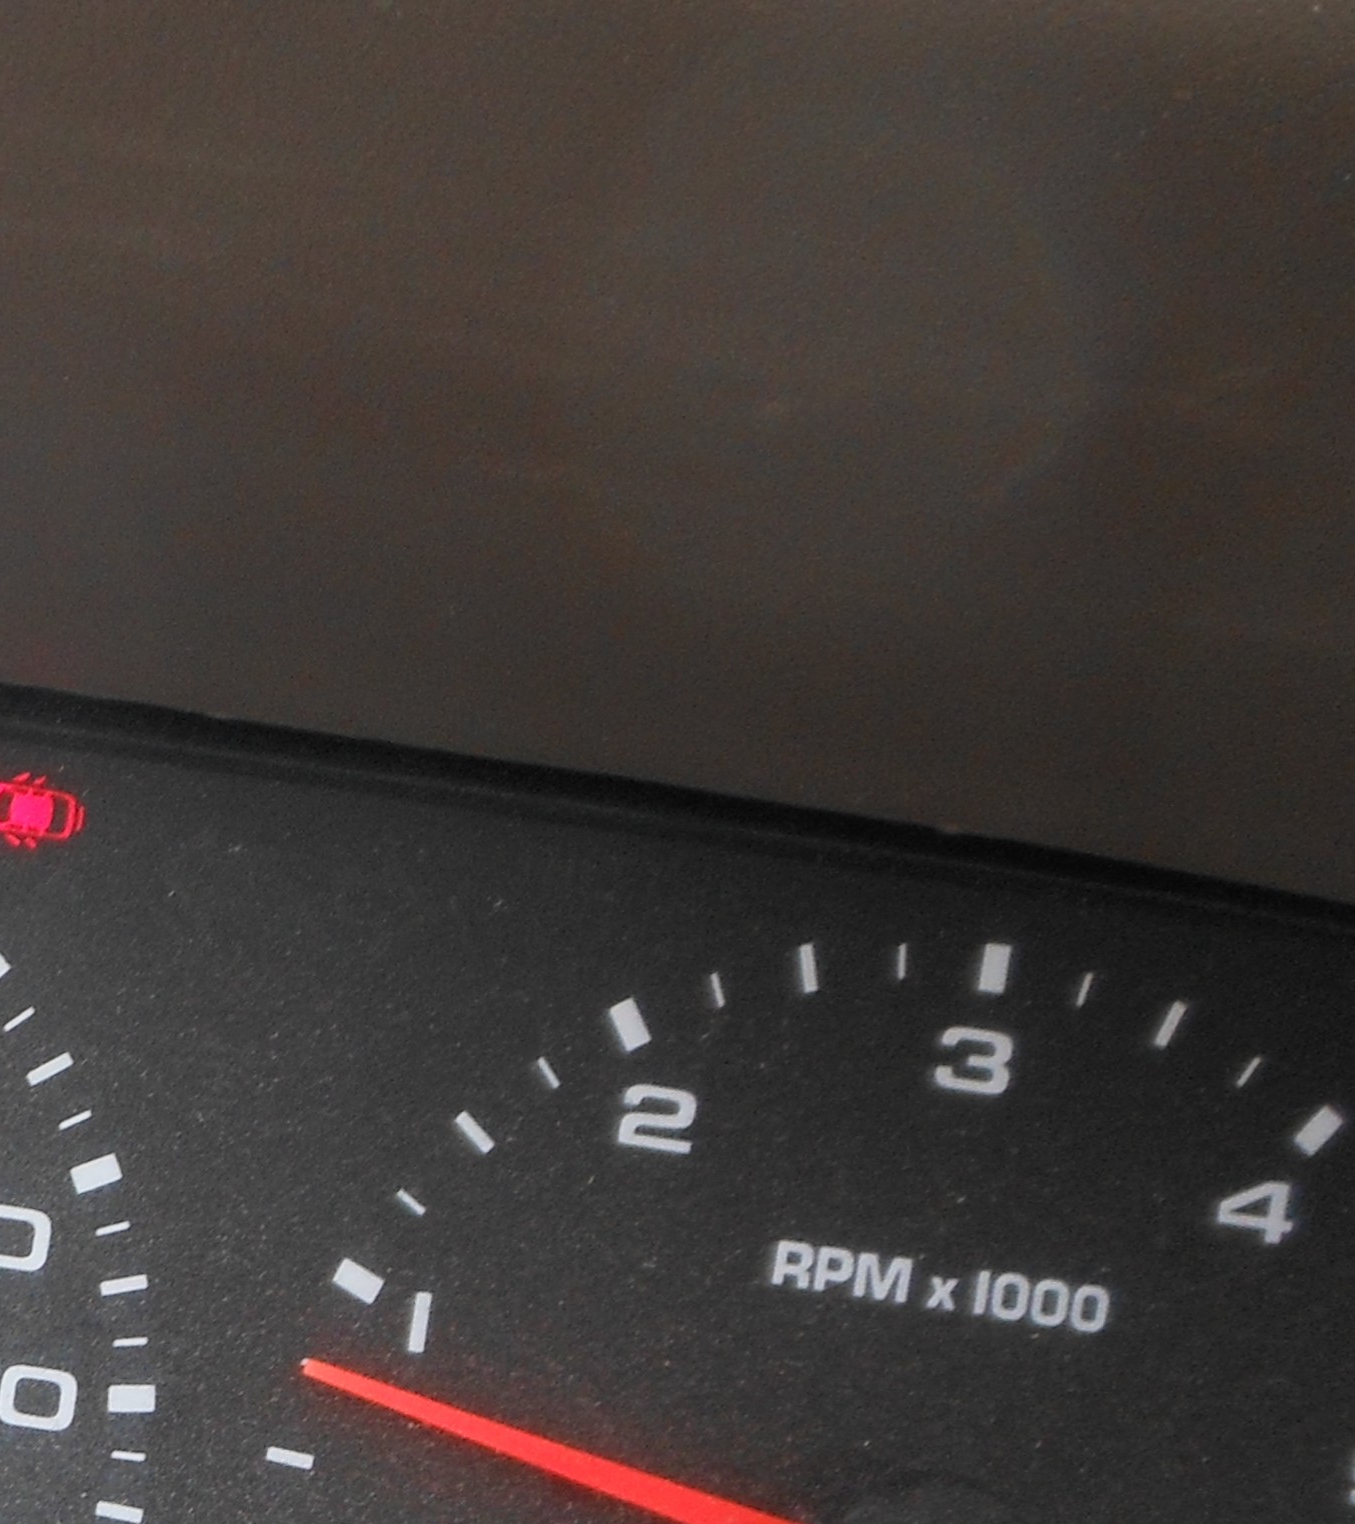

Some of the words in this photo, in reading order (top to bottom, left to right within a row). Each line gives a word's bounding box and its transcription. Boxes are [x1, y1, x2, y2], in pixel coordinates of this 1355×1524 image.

[933, 1026, 1014, 1095] 3
[616, 1083, 697, 1154] 2
[1216, 1181, 1294, 1244] 4
[770, 1239, 913, 1304] RPM
[971, 1269, 1110, 1333] 1000
[407, 1291, 433, 1354] 1
